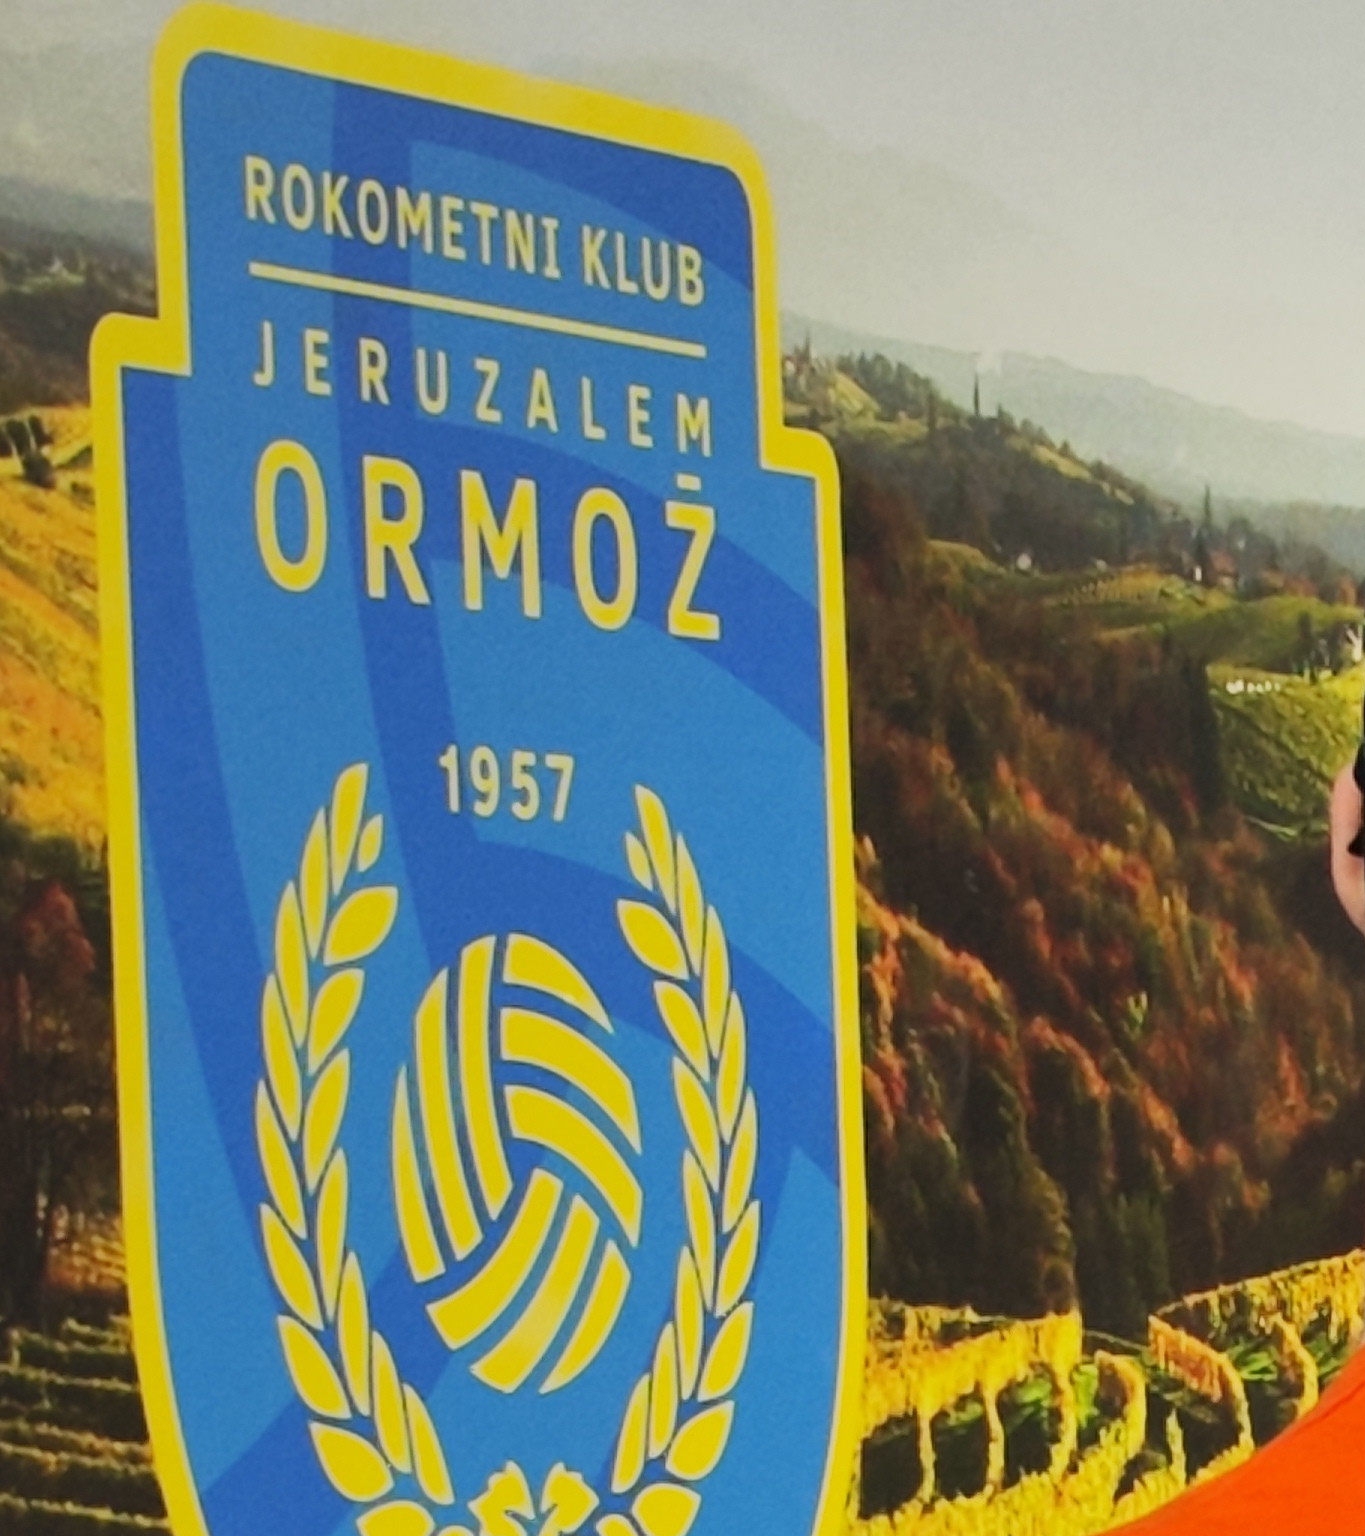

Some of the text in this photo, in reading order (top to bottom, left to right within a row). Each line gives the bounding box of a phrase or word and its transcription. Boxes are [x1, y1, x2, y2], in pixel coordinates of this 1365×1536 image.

[244, 154, 706, 307] ROKOMETNI KLUB
[253, 320, 713, 458] JERUZALEM
[253, 438, 722, 641] ORMOŽ
[438, 744, 575, 822] 1957
